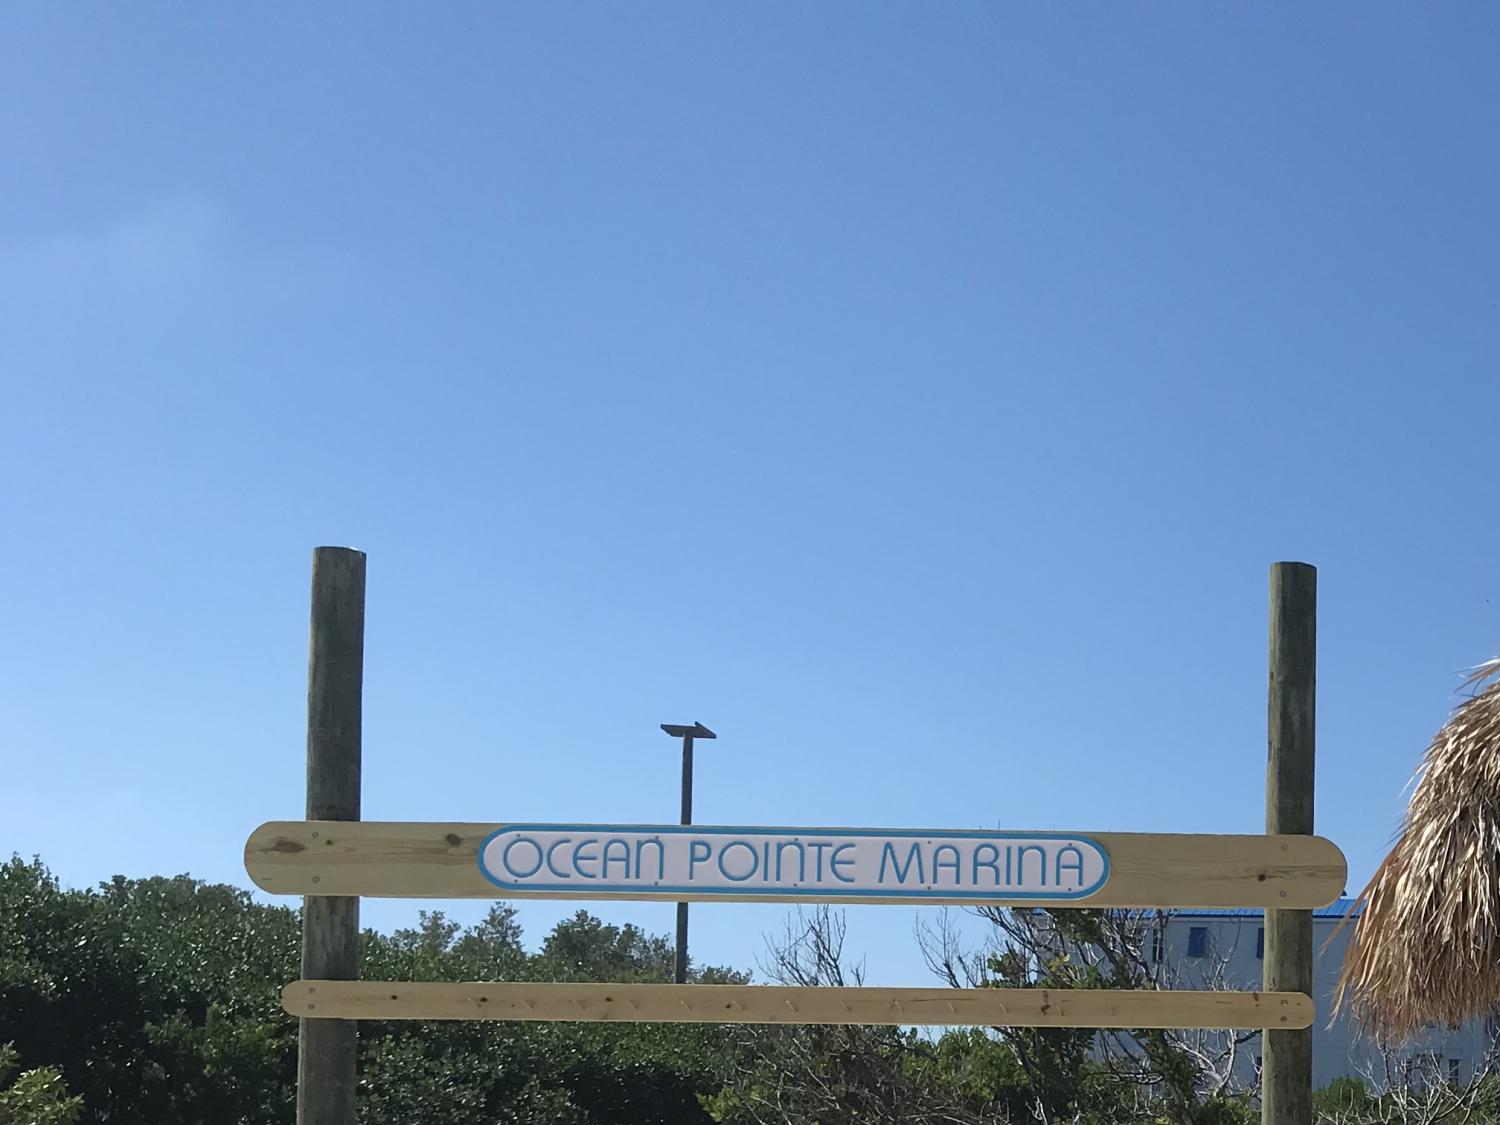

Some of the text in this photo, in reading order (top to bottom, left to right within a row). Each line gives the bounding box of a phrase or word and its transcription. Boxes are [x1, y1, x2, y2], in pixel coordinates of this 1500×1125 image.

[503, 837, 1083, 886] OCEAN POINTE MARINA
